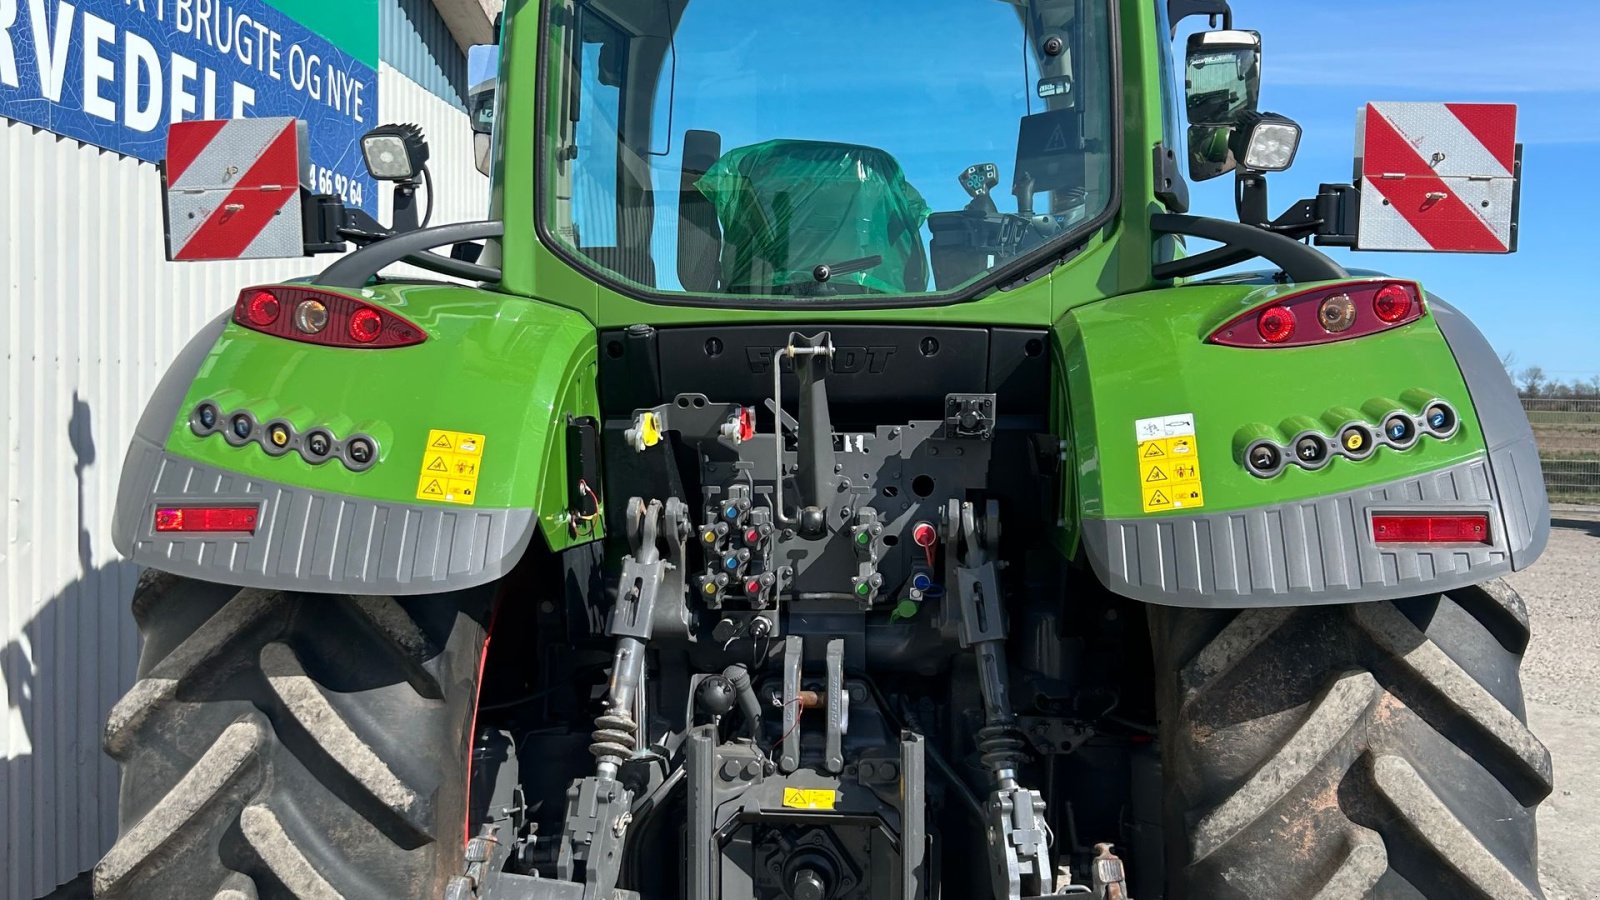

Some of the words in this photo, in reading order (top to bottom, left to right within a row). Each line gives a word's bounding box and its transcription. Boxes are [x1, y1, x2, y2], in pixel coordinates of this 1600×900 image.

[177, 0, 281, 80] BRUGTE
[289, 44, 321, 100] OG
[328, 64, 363, 123] NYE
[319, 166, 333, 195] 66
[335, 173, 348, 202] 92
[350, 179, 362, 207] 64
[745, 346, 897, 374] FDT
